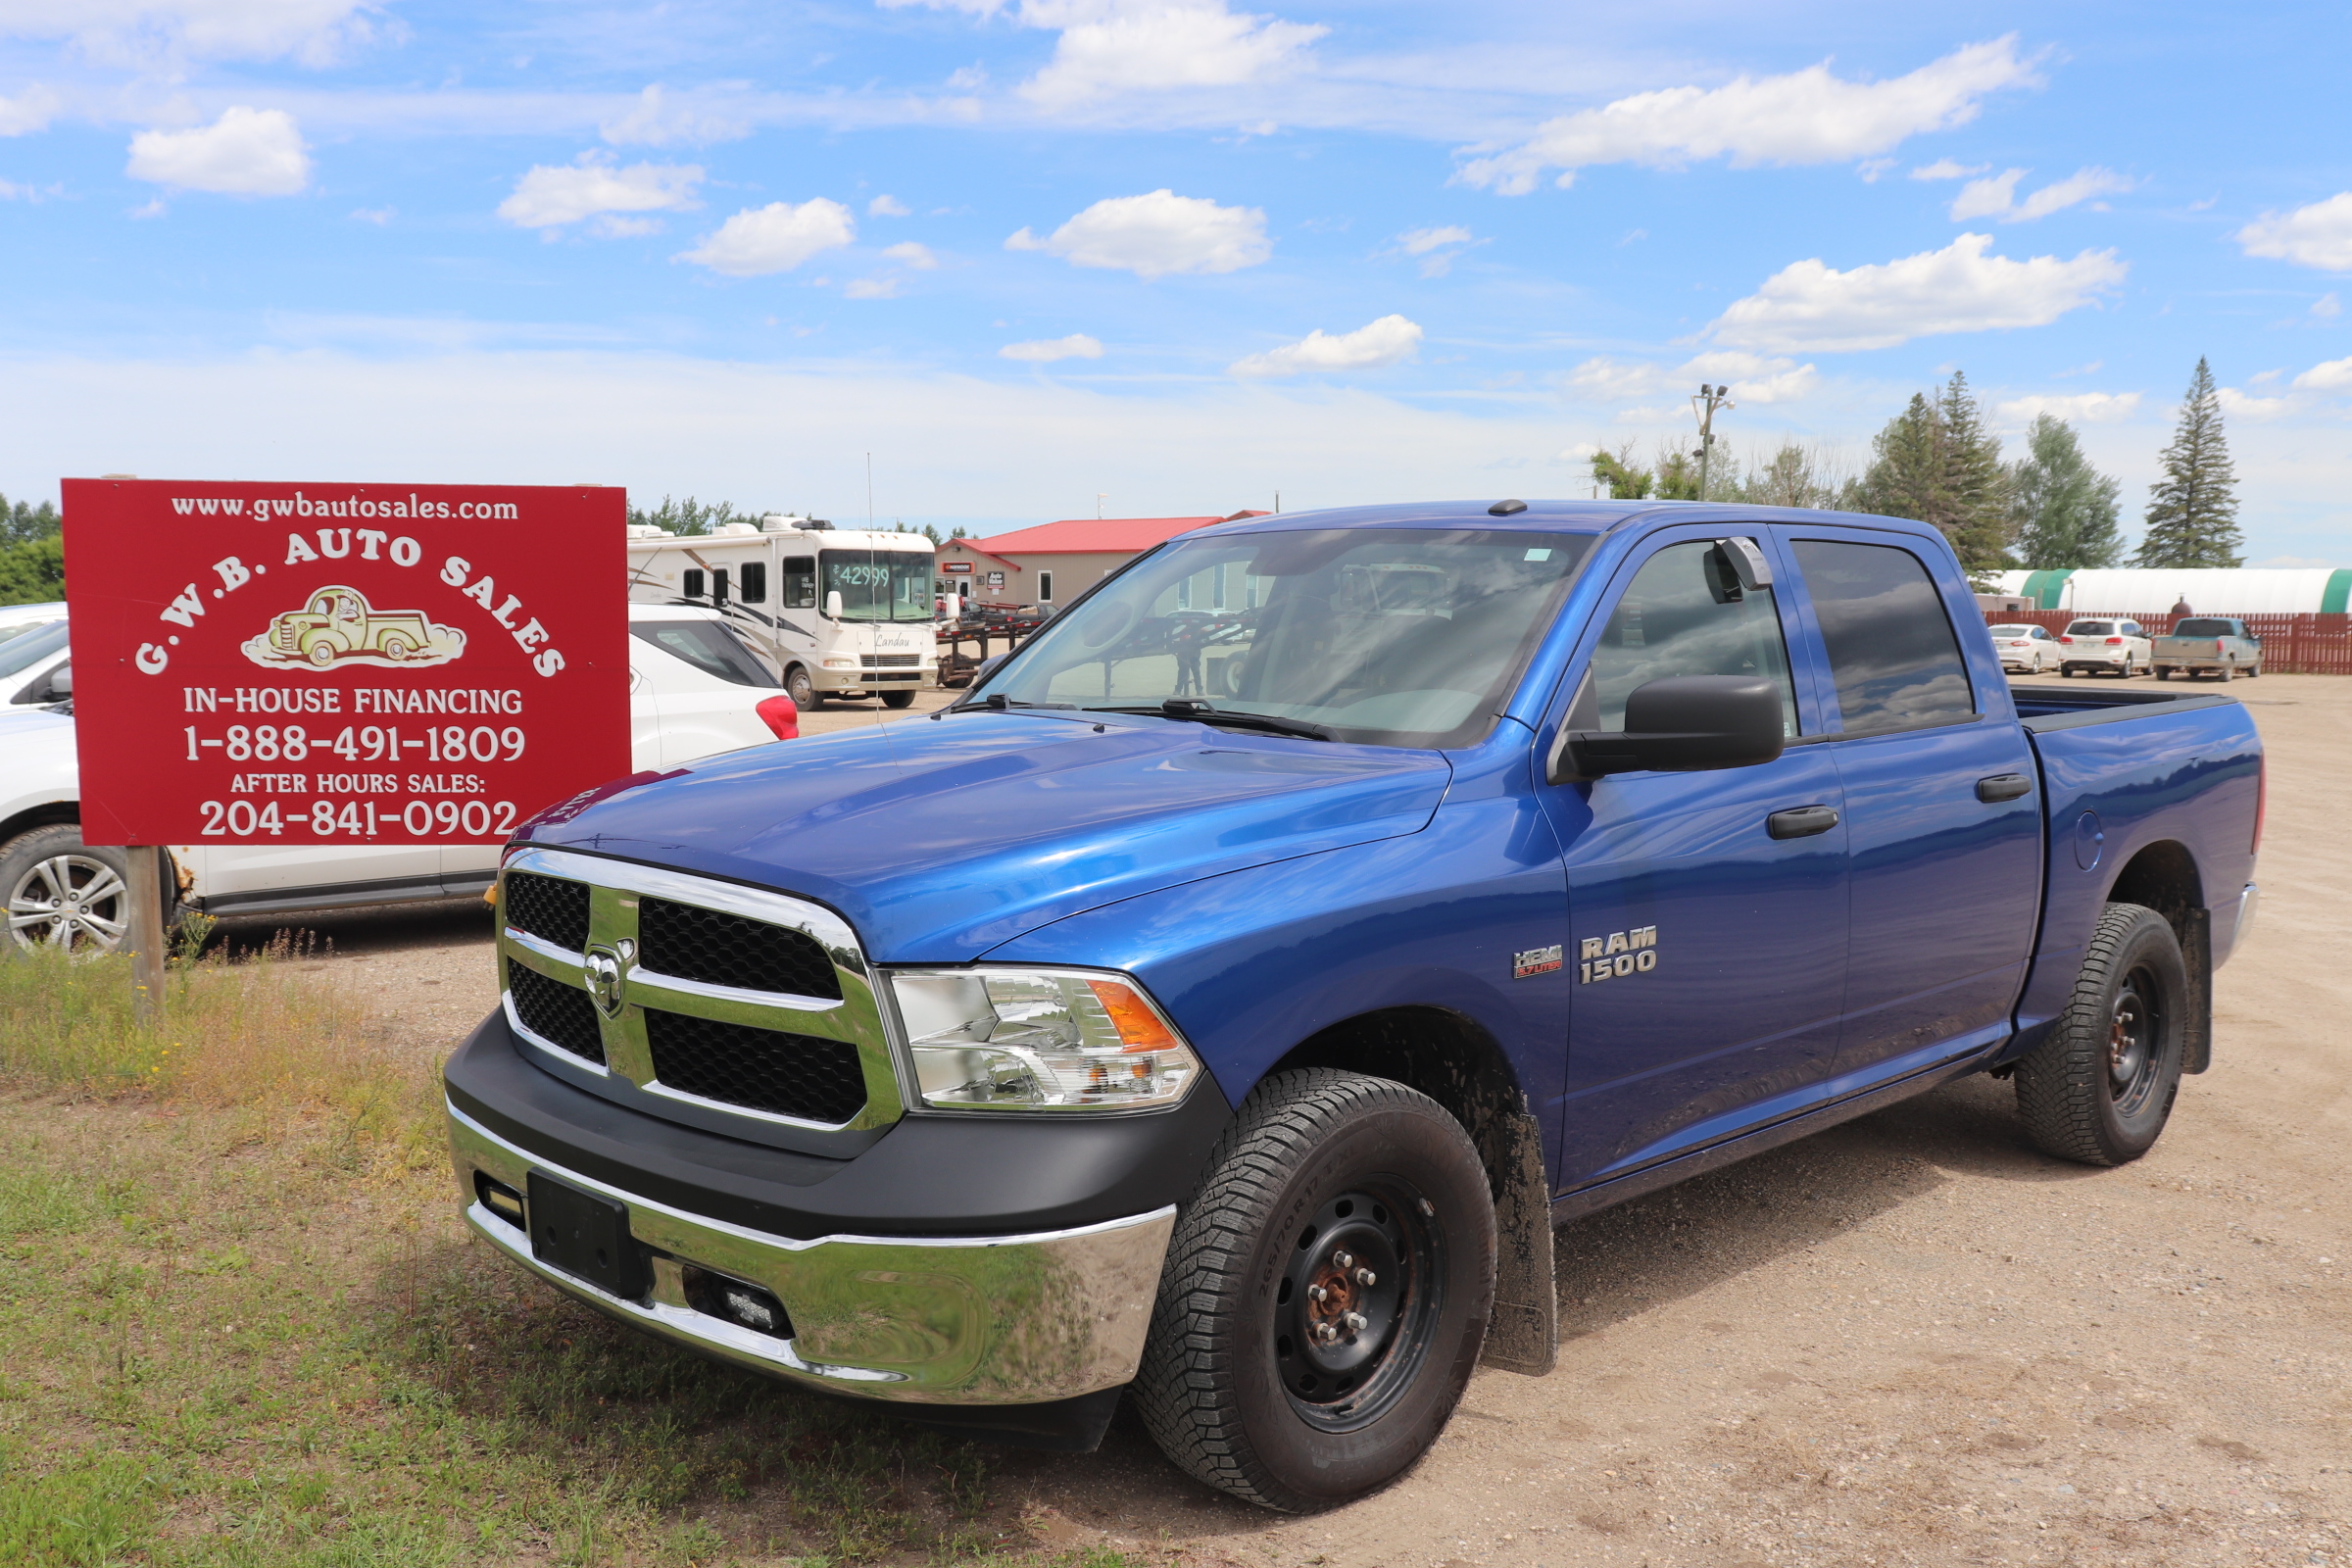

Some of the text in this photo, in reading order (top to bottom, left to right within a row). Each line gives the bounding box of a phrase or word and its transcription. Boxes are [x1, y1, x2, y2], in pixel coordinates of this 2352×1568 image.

[172, 491, 518, 522] www.gwbautosales.com
[135, 528, 566, 677] G.W.B. AUTO SALES
[874, 632, 910, 647] Landau
[184, 688, 523, 714] IN-HOUSE FINANCING
[184, 725, 526, 761] 1-888-491-1809
[230, 773, 485, 793] AFTER HOURS SALES:
[200, 801, 519, 835] 204-841-0902
[1514, 944, 1562, 966] HEMI
[1580, 925, 1656, 960] RAM
[1517, 965, 1535, 977] 5.7
[1580, 950, 1656, 985] 1500
